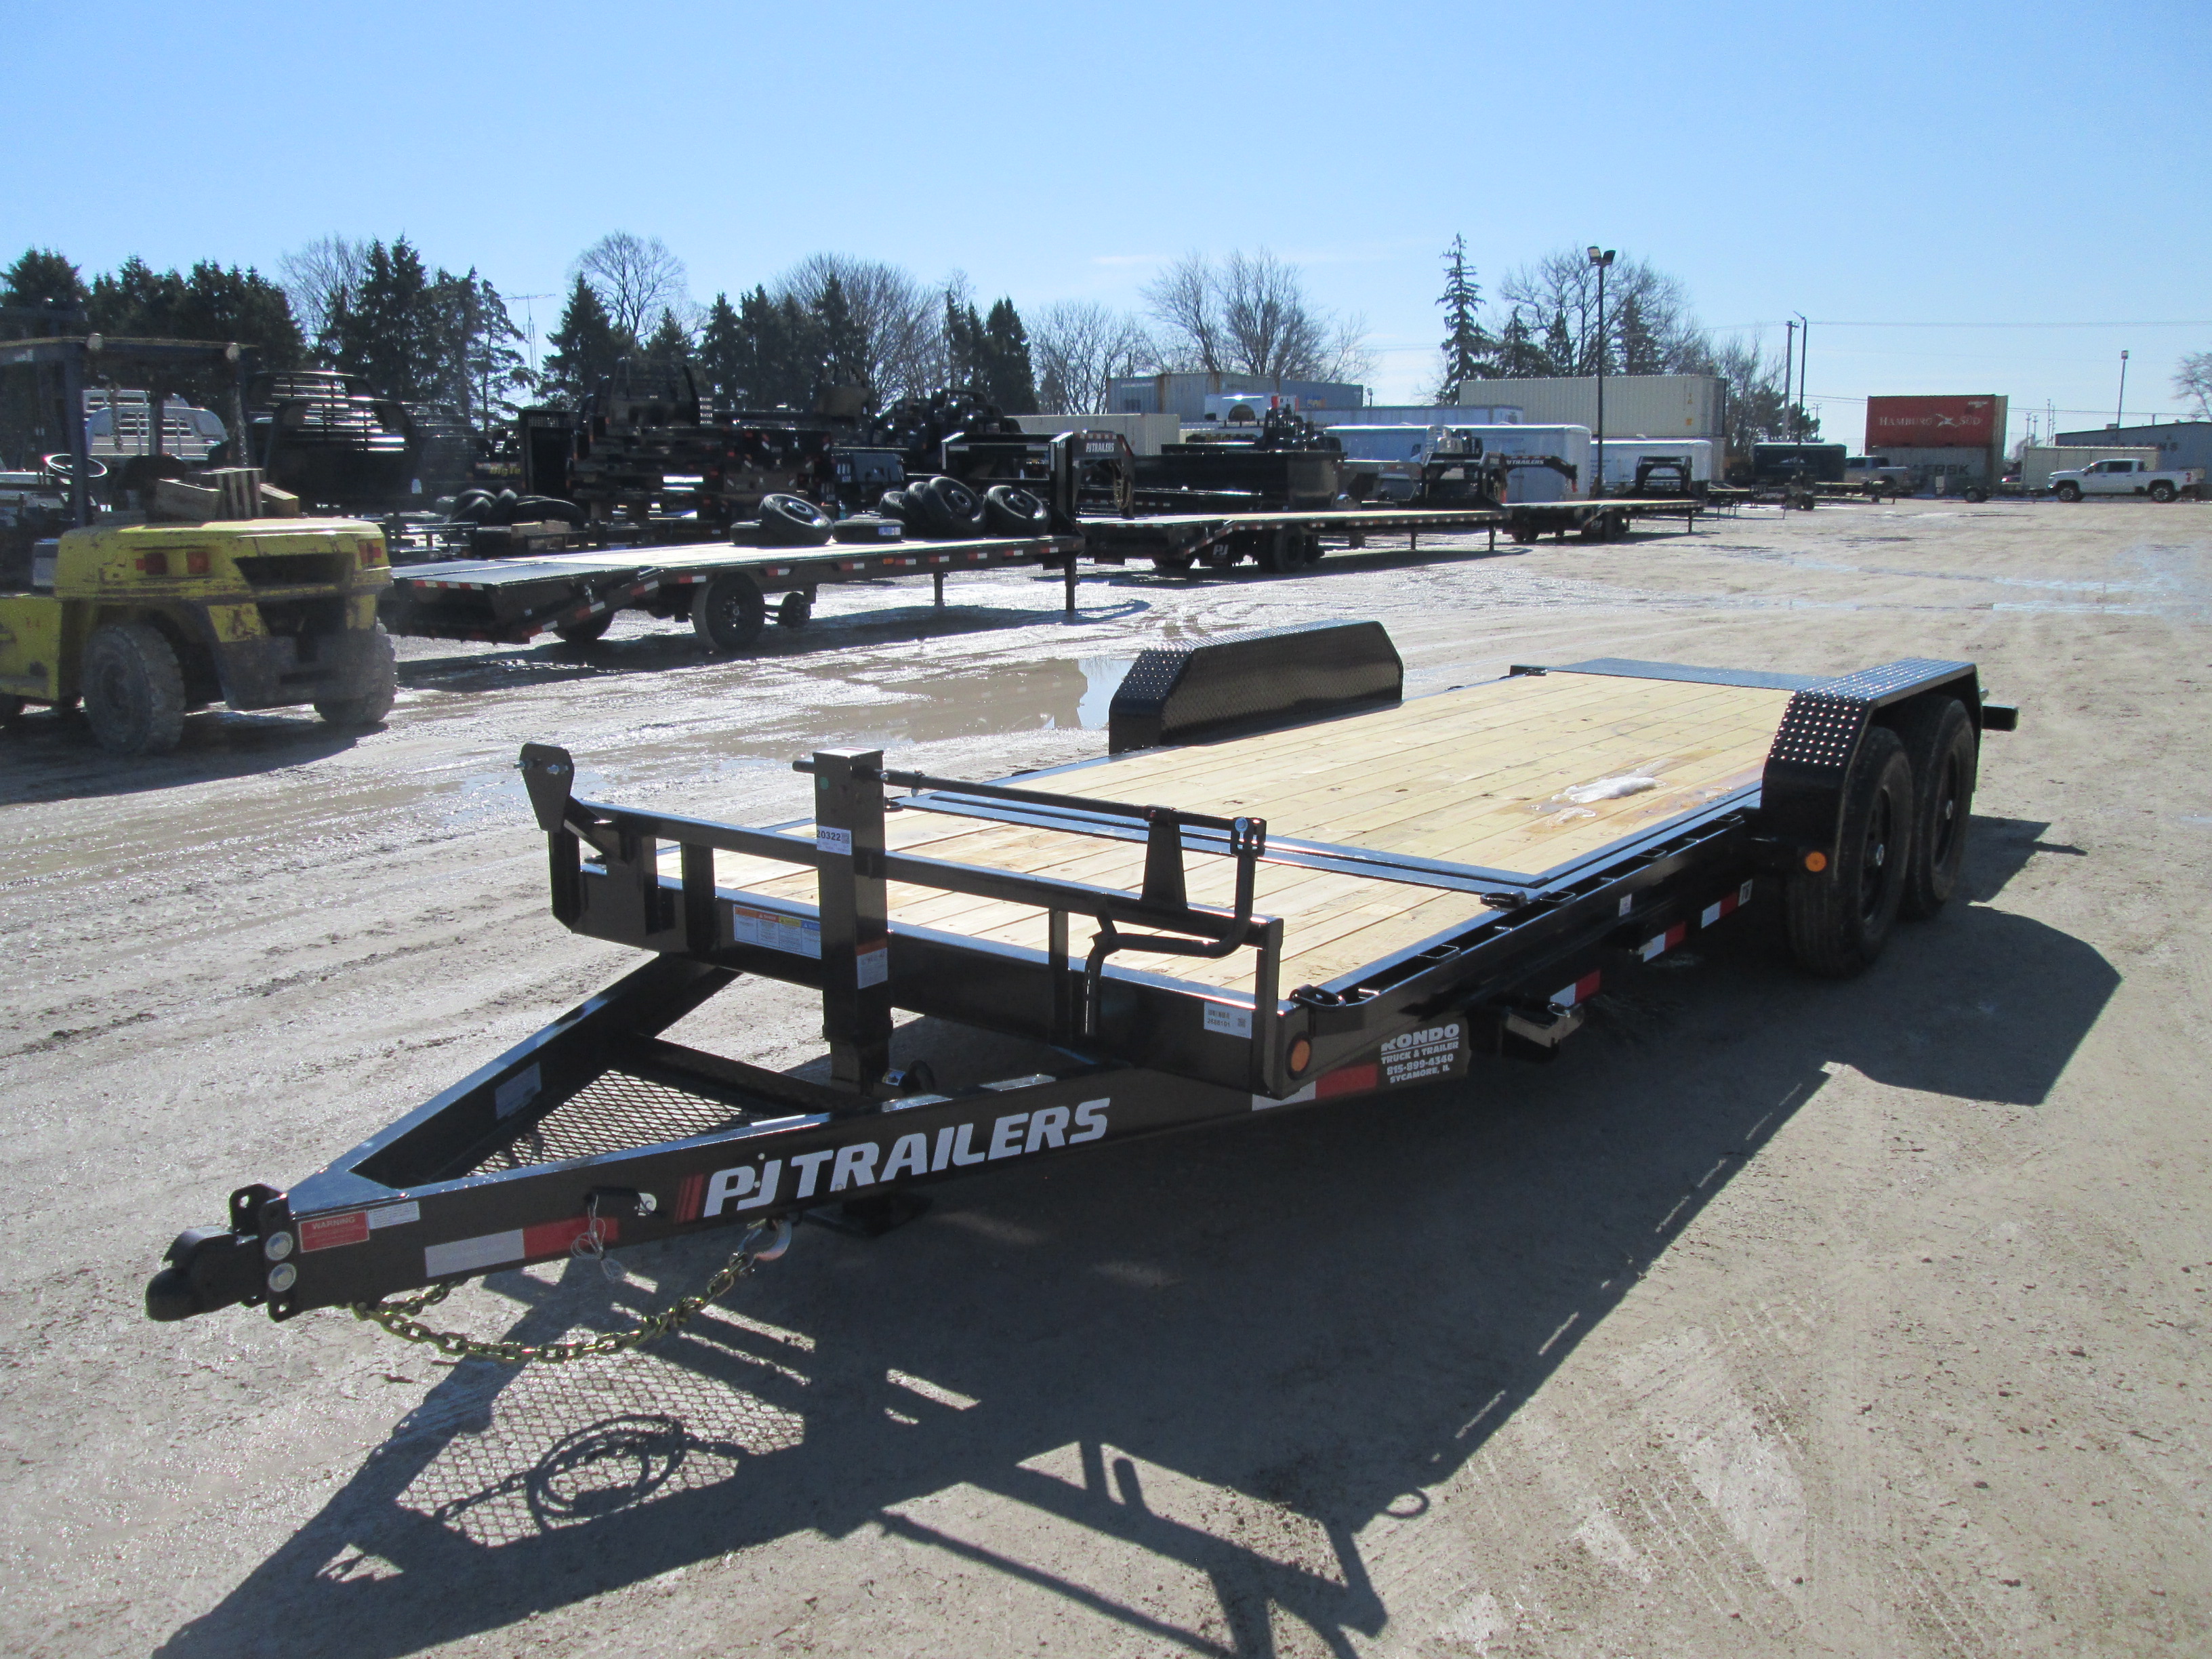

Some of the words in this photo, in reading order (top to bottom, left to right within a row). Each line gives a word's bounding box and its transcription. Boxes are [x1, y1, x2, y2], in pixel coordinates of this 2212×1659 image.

[1879, 416, 1932, 426] HAMBURG
[1213, 544, 1229, 556] PJ
[1381, 1051, 1412, 1065] TRUCK
[1413, 1049, 1420, 1058] &
[1421, 1041, 1459, 1056] TRAILER
[1387, 1053, 1454, 1076] 815-899-4340
[1389, 1067, 1440, 1083] SYCAMORE,
[703, 1159, 782, 1218] PJ
[790, 1097, 1111, 1199] TRAILERS
[312, 1216, 356, 1230] WARNING
